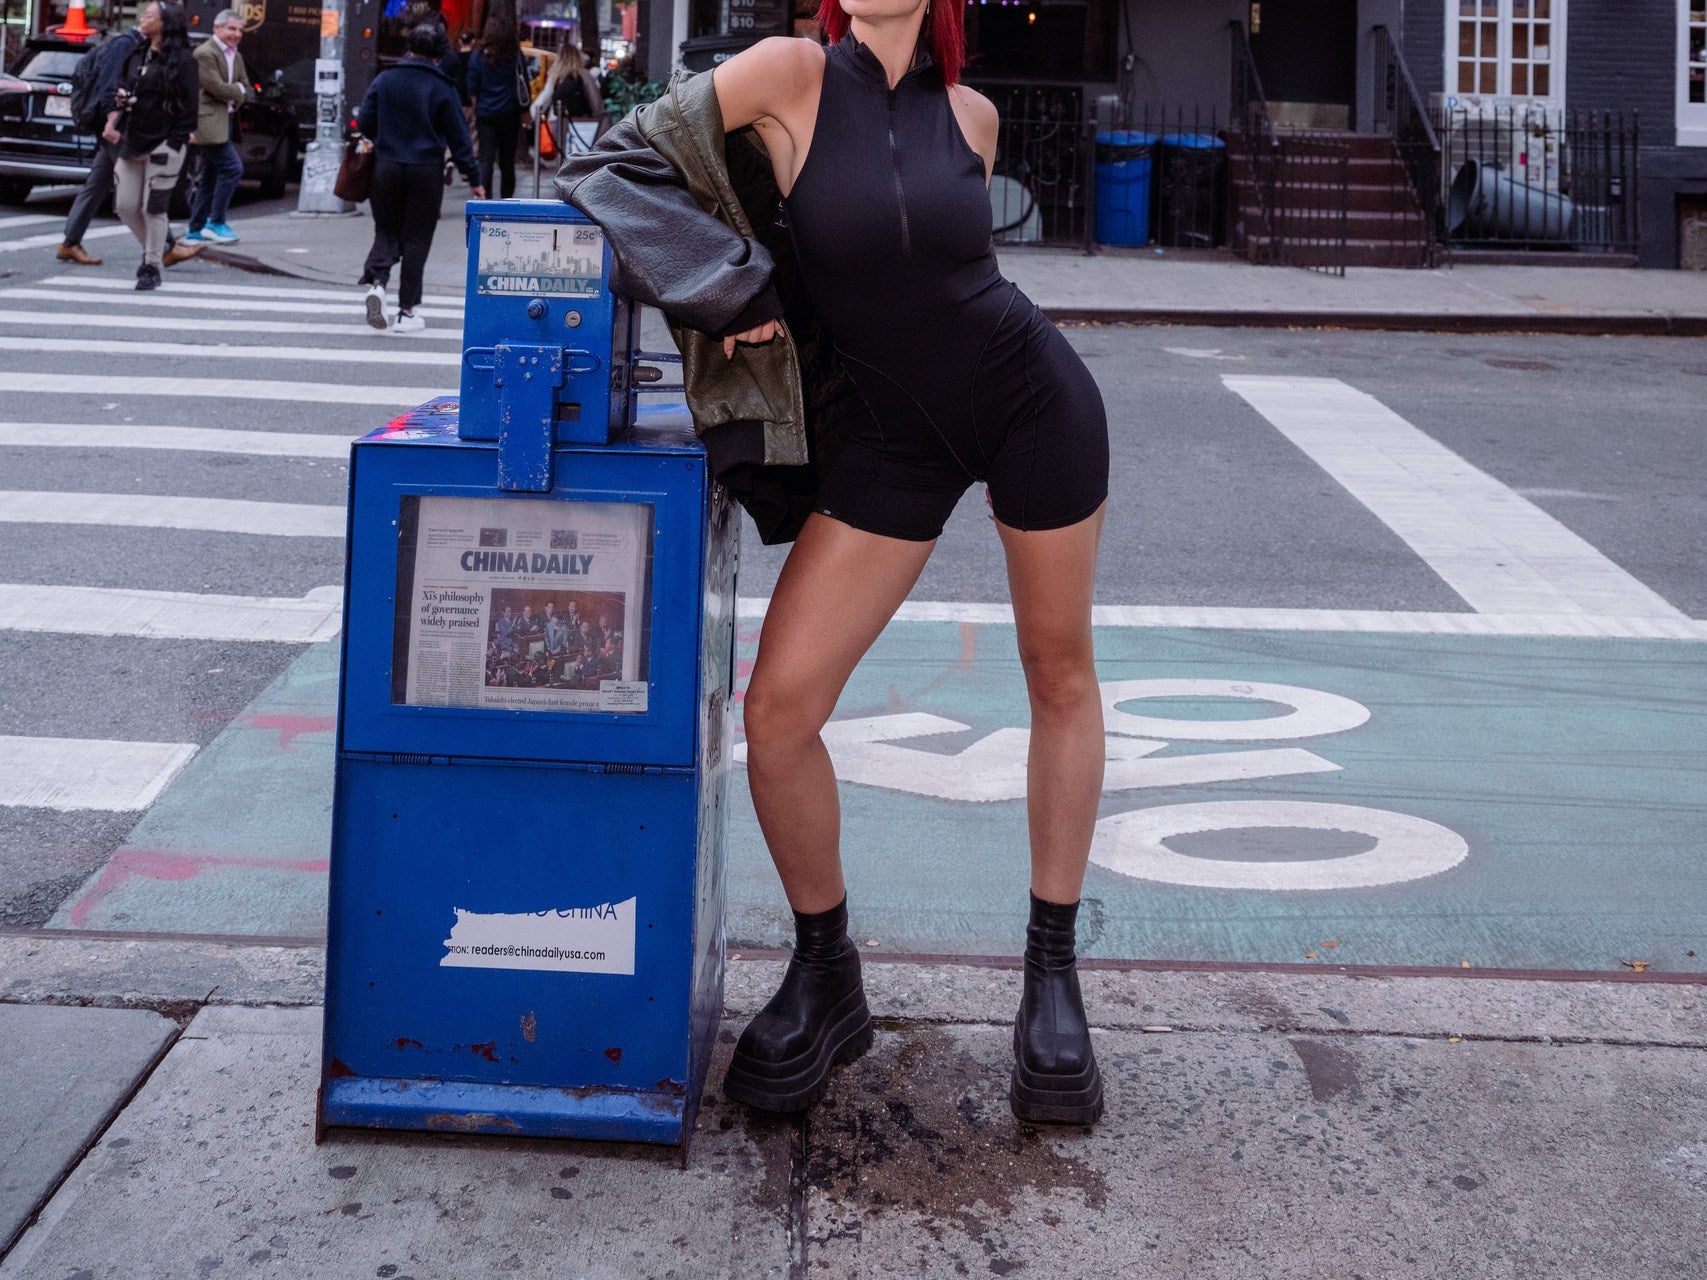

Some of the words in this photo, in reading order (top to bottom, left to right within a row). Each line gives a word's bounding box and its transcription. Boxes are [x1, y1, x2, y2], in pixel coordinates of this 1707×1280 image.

[730, 15, 755, 29] $10
[487, 276, 540, 291] CHINA
[541, 278, 588, 293] DAILY
[460, 550, 529, 573] CHINA
[531, 553, 594, 575] DAILY
[439, 591, 485, 605] philosophy
[421, 604, 431, 613] of
[432, 606, 479, 616] governance
[421, 616, 447, 629] widely
[448, 618, 480, 629] praised
[547, 698, 559, 706] first
[578, 700, 595, 708] prime
[448, 945, 469, 954] TION:
[471, 944, 606, 961] readers@chinadailyusa.com
